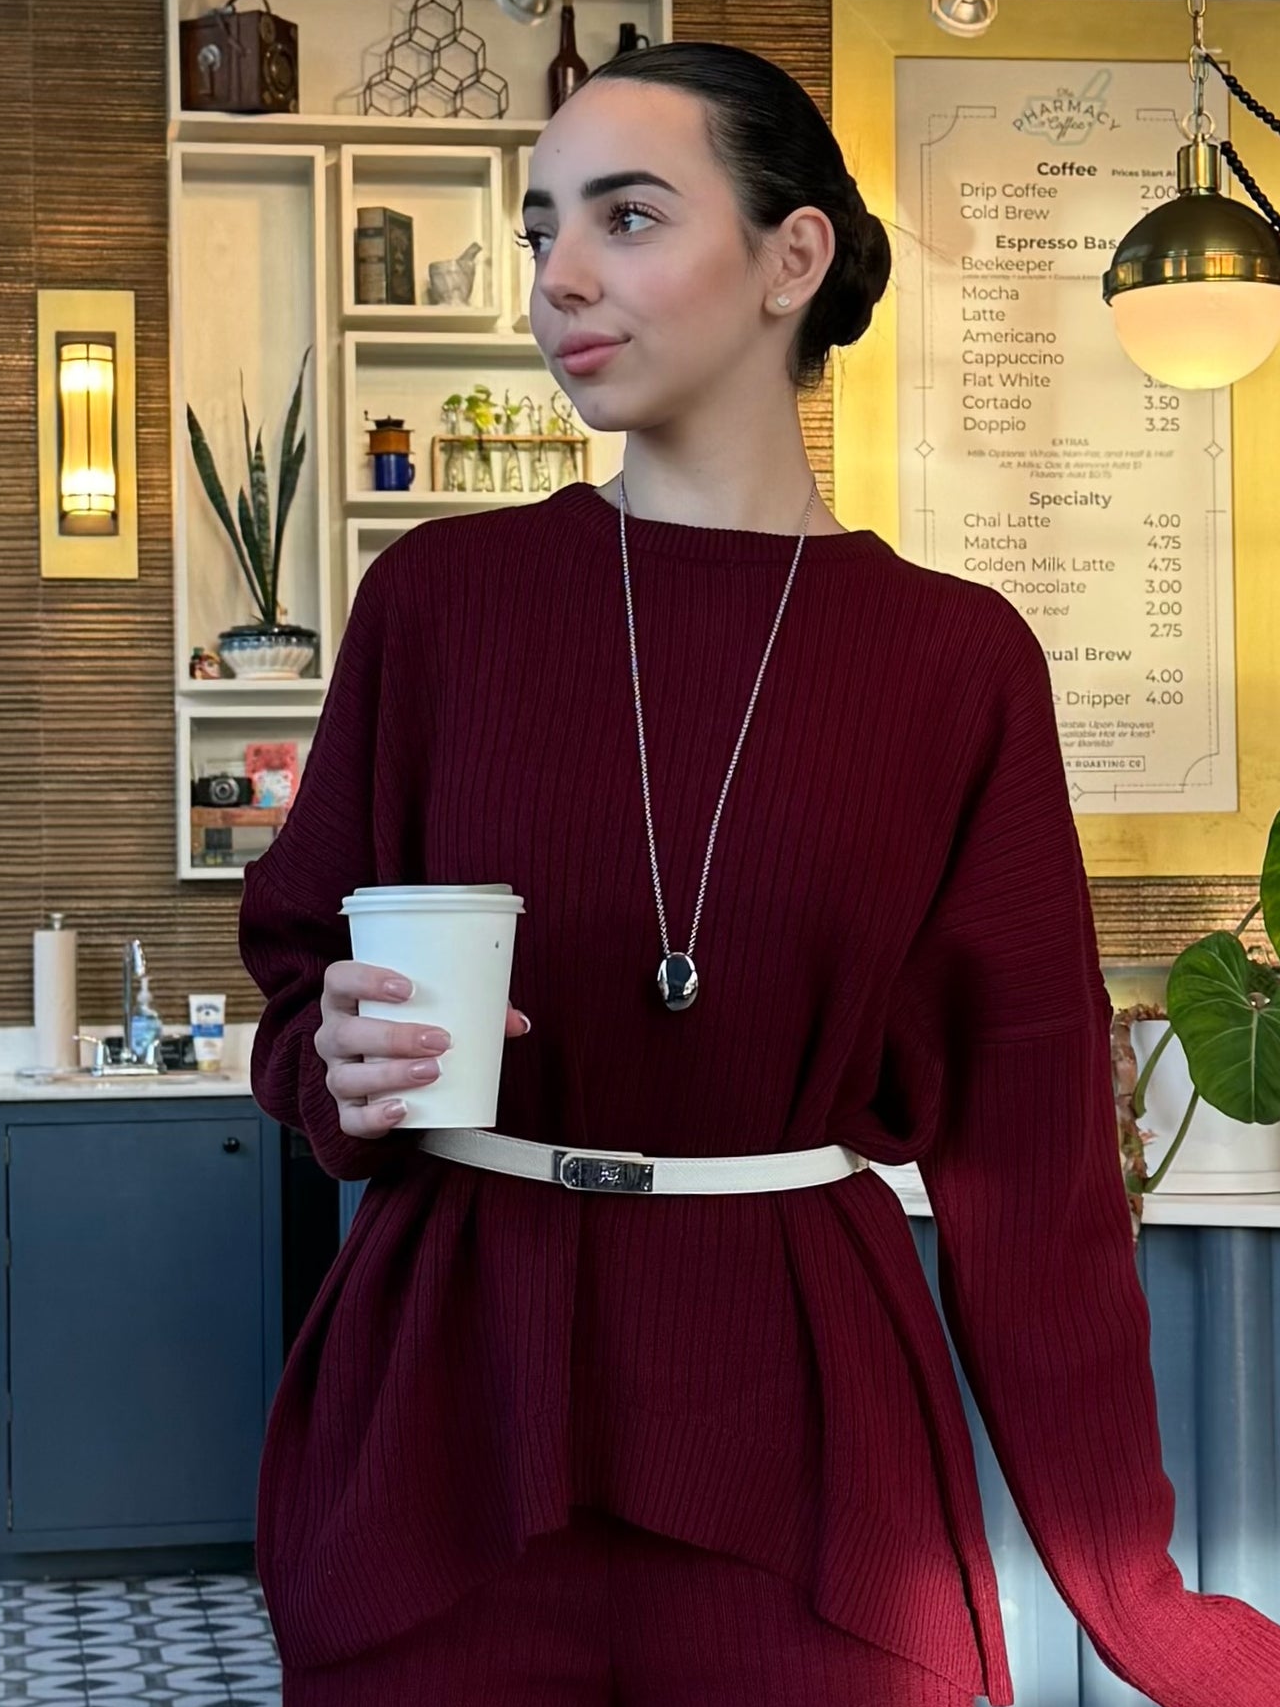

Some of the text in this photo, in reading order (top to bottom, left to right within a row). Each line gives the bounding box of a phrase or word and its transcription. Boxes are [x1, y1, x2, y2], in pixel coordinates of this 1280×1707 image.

[1012, 99, 1121, 132] PHARMACY
[1037, 162, 1098, 177] Coffee
[1111, 169, 1139, 178] Prices
[1141, 169, 1164, 178] Start
[960, 182, 998, 200] Drip
[1001, 183, 1059, 199] Coffee
[960, 205, 1050, 220] Cold Brew
[995, 235, 1118, 253] Espresso Bas
[961, 255, 1055, 274] Beekeeper
[961, 286, 1020, 301] Mocha
[961, 307, 1007, 323] Latte
[962, 328, 1058, 344] Americano
[961, 349, 1065, 368] Cappuccino
[962, 372, 995, 388] Flat
[999, 372, 1052, 388] White
[962, 394, 1180, 411] Cortado 3.50
[963, 416, 1181, 435] Doppio 3.25
[1051, 438, 1090, 447] EXTRAS
[1029, 491, 1112, 509] Specialty
[963, 513, 1182, 529] Chai Latte 4.00
[963, 535, 1182, 550] Matcha 4.75
[963, 556, 1183, 573] Golden Milk Latte 4.75
[1001, 579, 1087, 594] Chocolate
[1144, 579, 1183, 594] 3.00
[1026, 601, 1183, 616] or Iced 2.00
[1149, 622, 1183, 638] 2.75
[1085, 647, 1132, 661] Brew
[1145, 668, 1184, 684] 4.00
[1066, 690, 1131, 708] Dripper
[1145, 690, 1184, 705] 4.00
[1075, 760, 1126, 769] ROASTING
